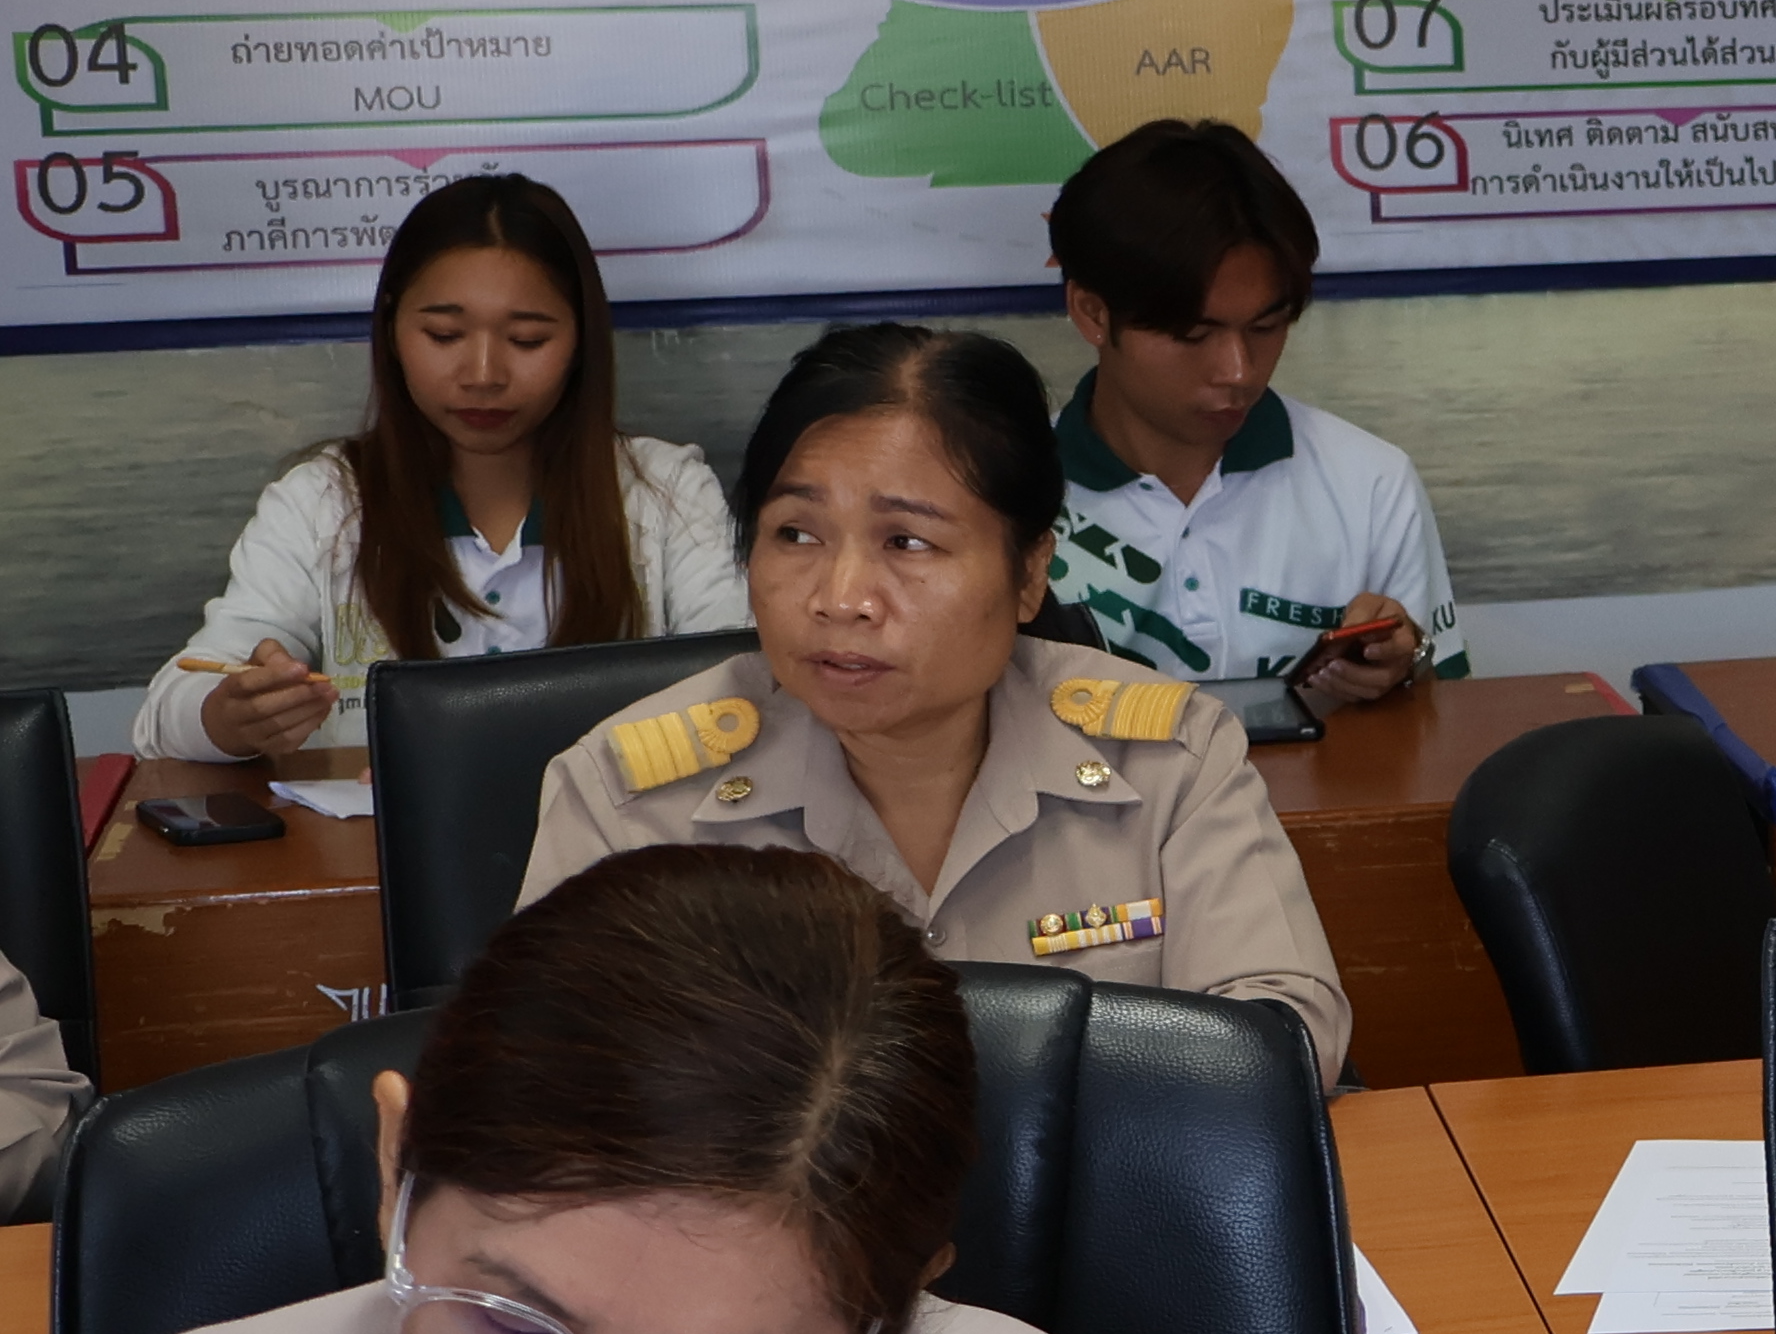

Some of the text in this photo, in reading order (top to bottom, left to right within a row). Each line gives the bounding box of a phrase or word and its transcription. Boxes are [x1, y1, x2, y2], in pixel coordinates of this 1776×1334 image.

[28, 20, 139, 88] 04
[230, 28, 554, 66] ถ่ายทอดค่าเป้าหมาย
[1135, 47, 1212, 76] AAR
[353, 85, 443, 113] MOU
[860, 77, 1053, 113] Check-list
[1354, 110, 1446, 171] 06
[1502, 118, 1574, 148] นิเทศ
[1586, 117, 1680, 148] ติดตาม
[37, 150, 146, 214] 05
